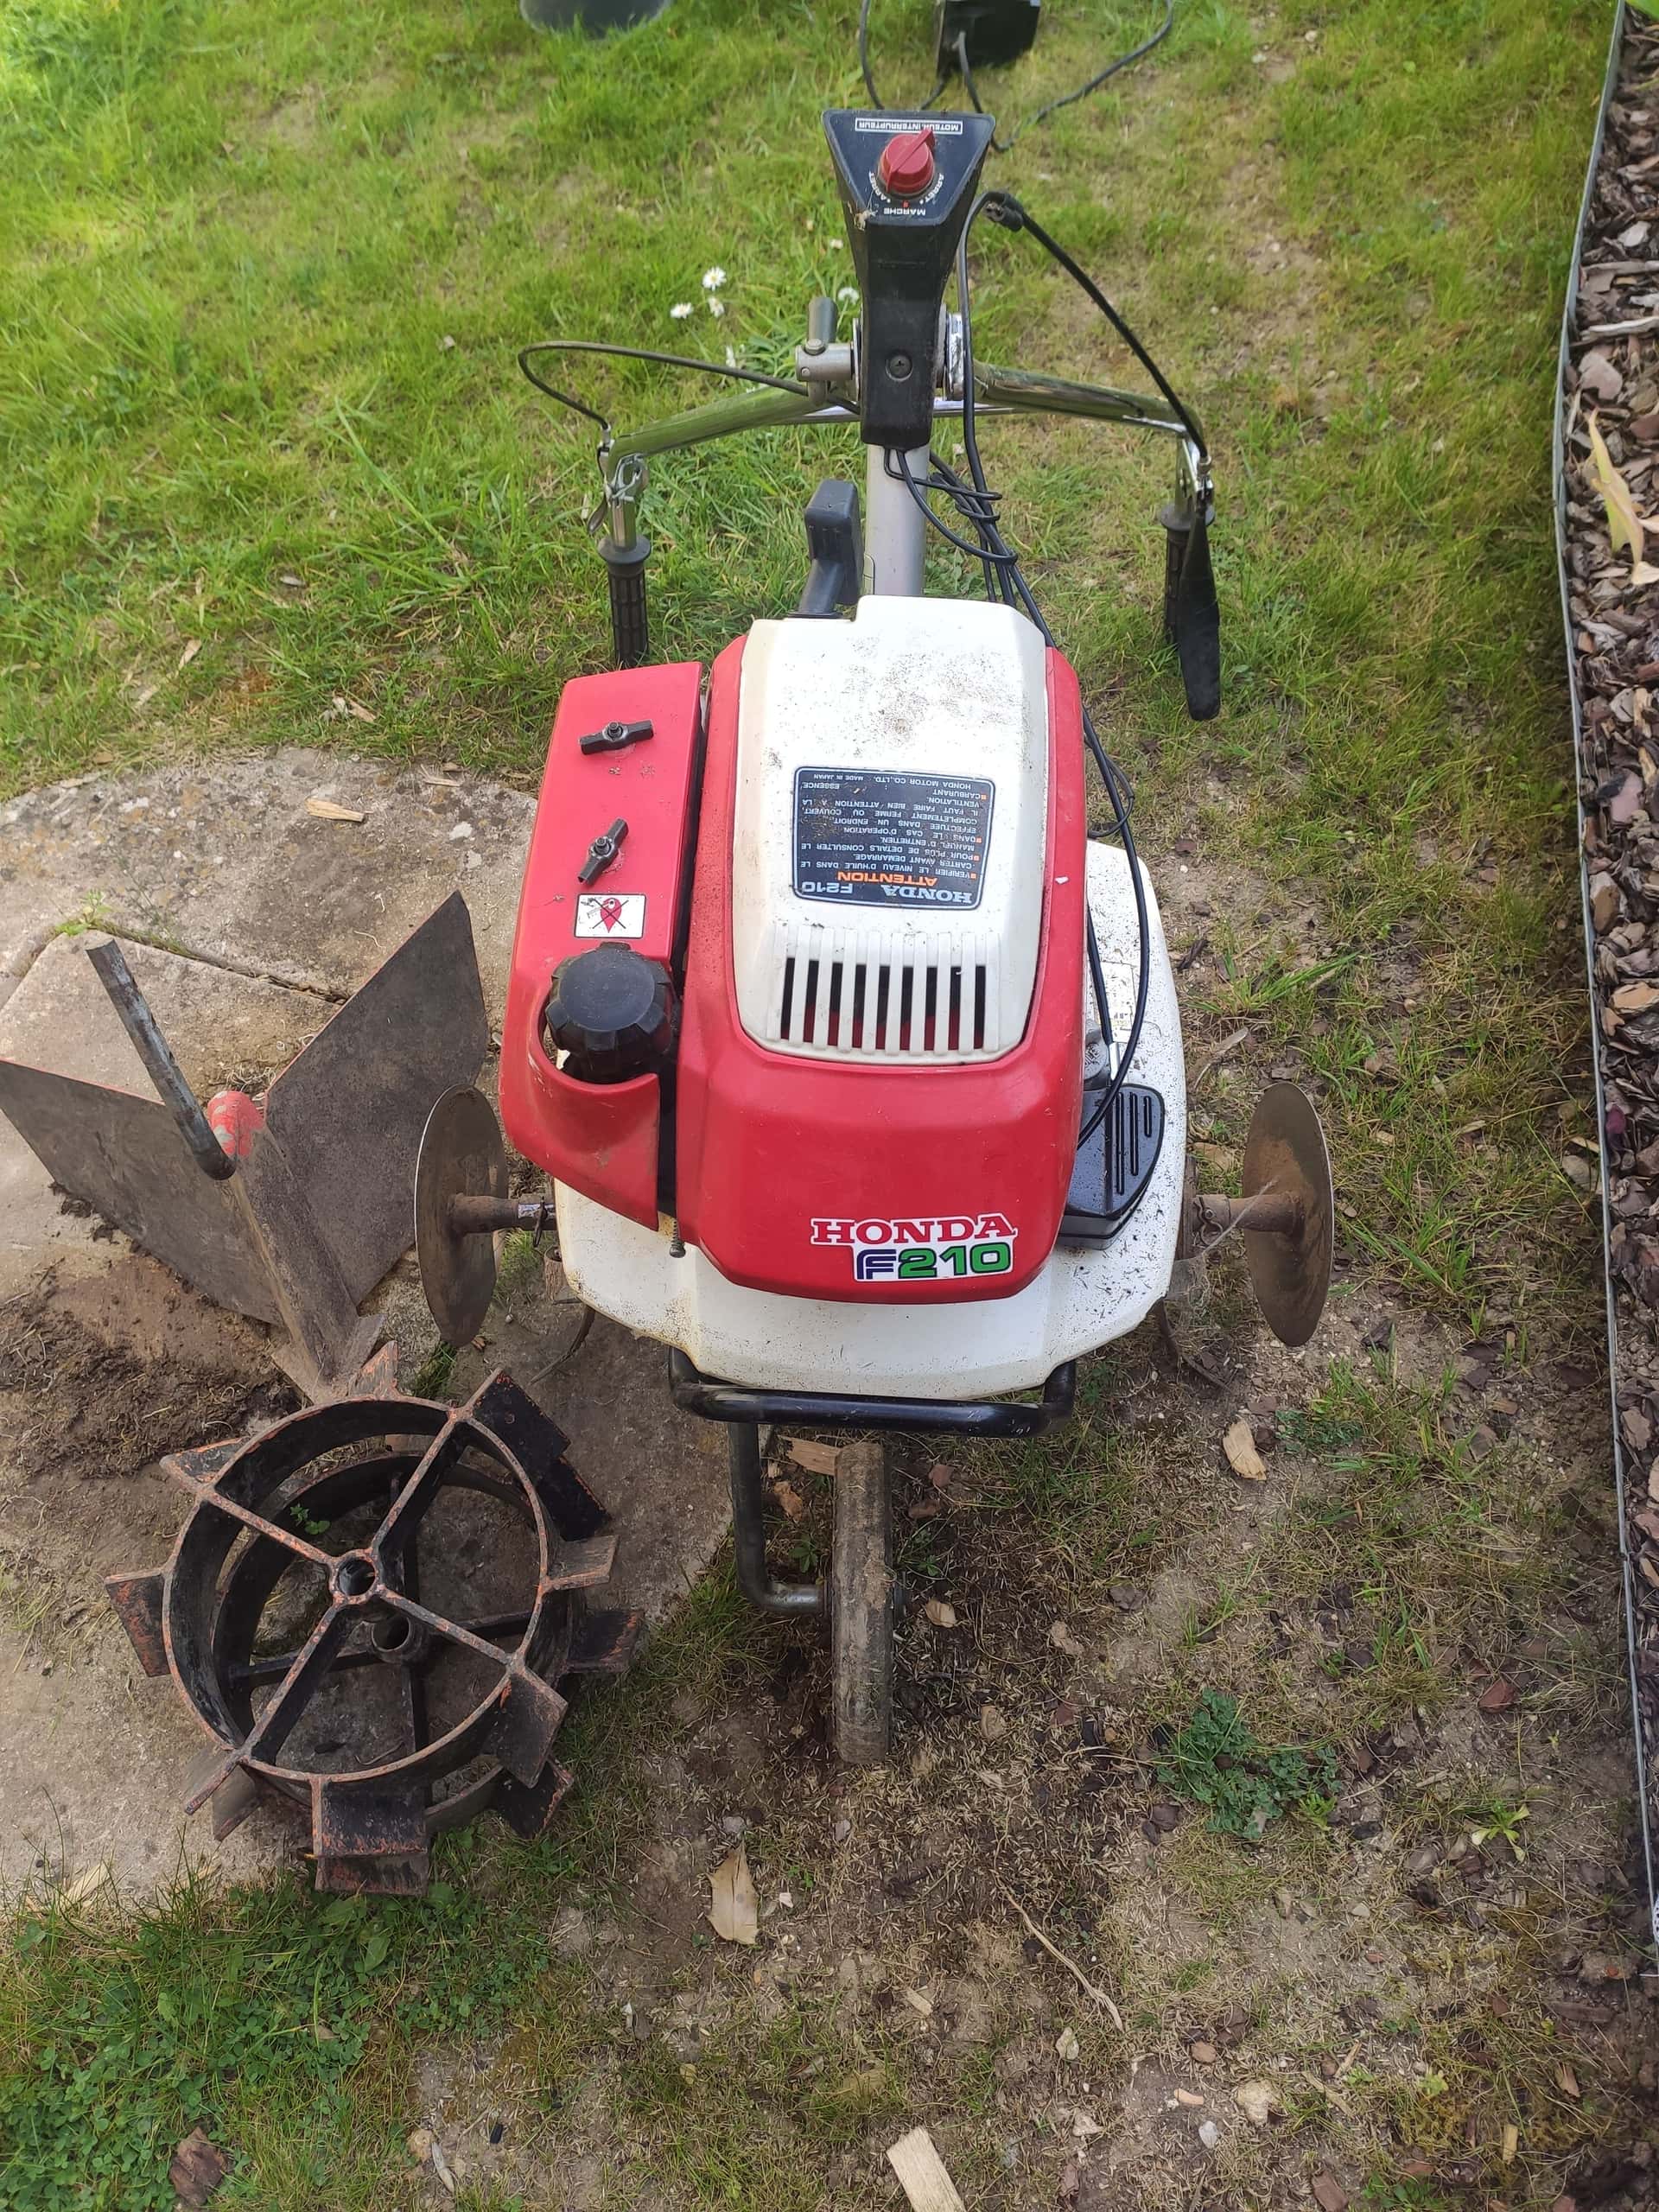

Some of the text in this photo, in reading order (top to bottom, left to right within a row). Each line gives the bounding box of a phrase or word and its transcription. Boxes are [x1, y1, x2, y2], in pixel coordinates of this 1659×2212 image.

[869, 170, 887, 200] ARRET
[925, 173, 944, 202] ARRET
[910, 779, 938, 787] MOTOR
[932, 789, 980, 799] CARBURANT
[912, 812, 976, 824] COMPLETEMENT
[930, 823, 976, 833] EFFECTUEE
[940, 860, 971, 869] CARTER
[837, 872, 938, 887] ATTENTION
[935, 868, 969, 879] VERIFIER
[802, 881, 972, 903] HONDA F210
[812, 1215, 1016, 1244] HONDA
[856, 1243, 1011, 1279] F210
